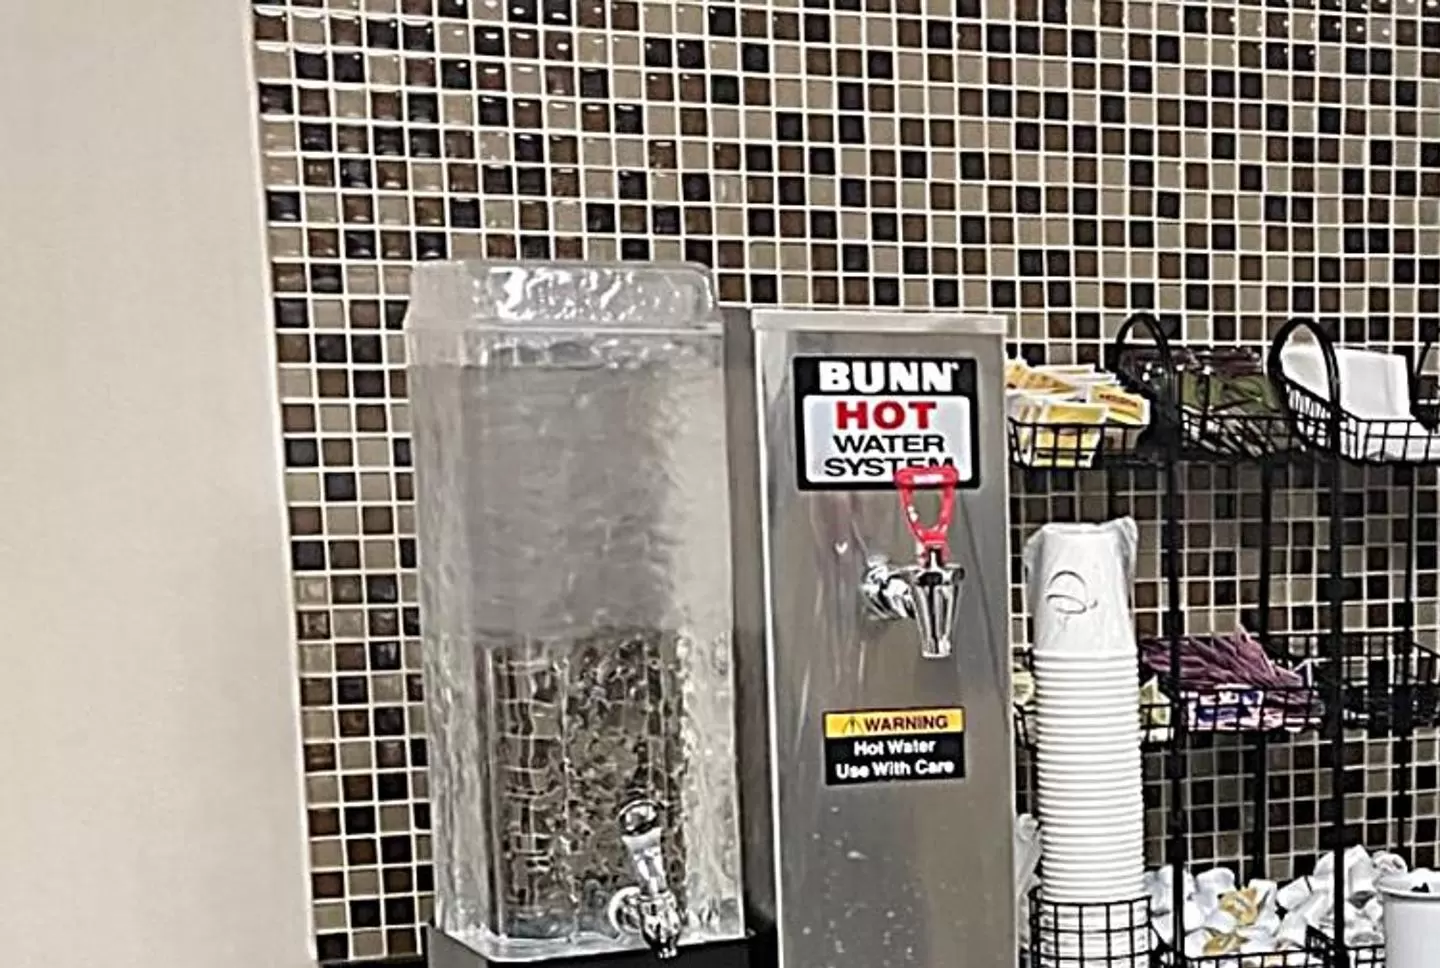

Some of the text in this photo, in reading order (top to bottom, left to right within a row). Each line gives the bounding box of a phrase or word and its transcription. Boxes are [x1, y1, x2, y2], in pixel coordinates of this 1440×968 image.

[819, 360, 954, 393] BUNN
[836, 400, 936, 430] HOT
[833, 434, 945, 453] WATER
[864, 715, 948, 732] WARNING
[854, 739, 936, 756] Hot Water
[835, 759, 955, 779] Use With Care
